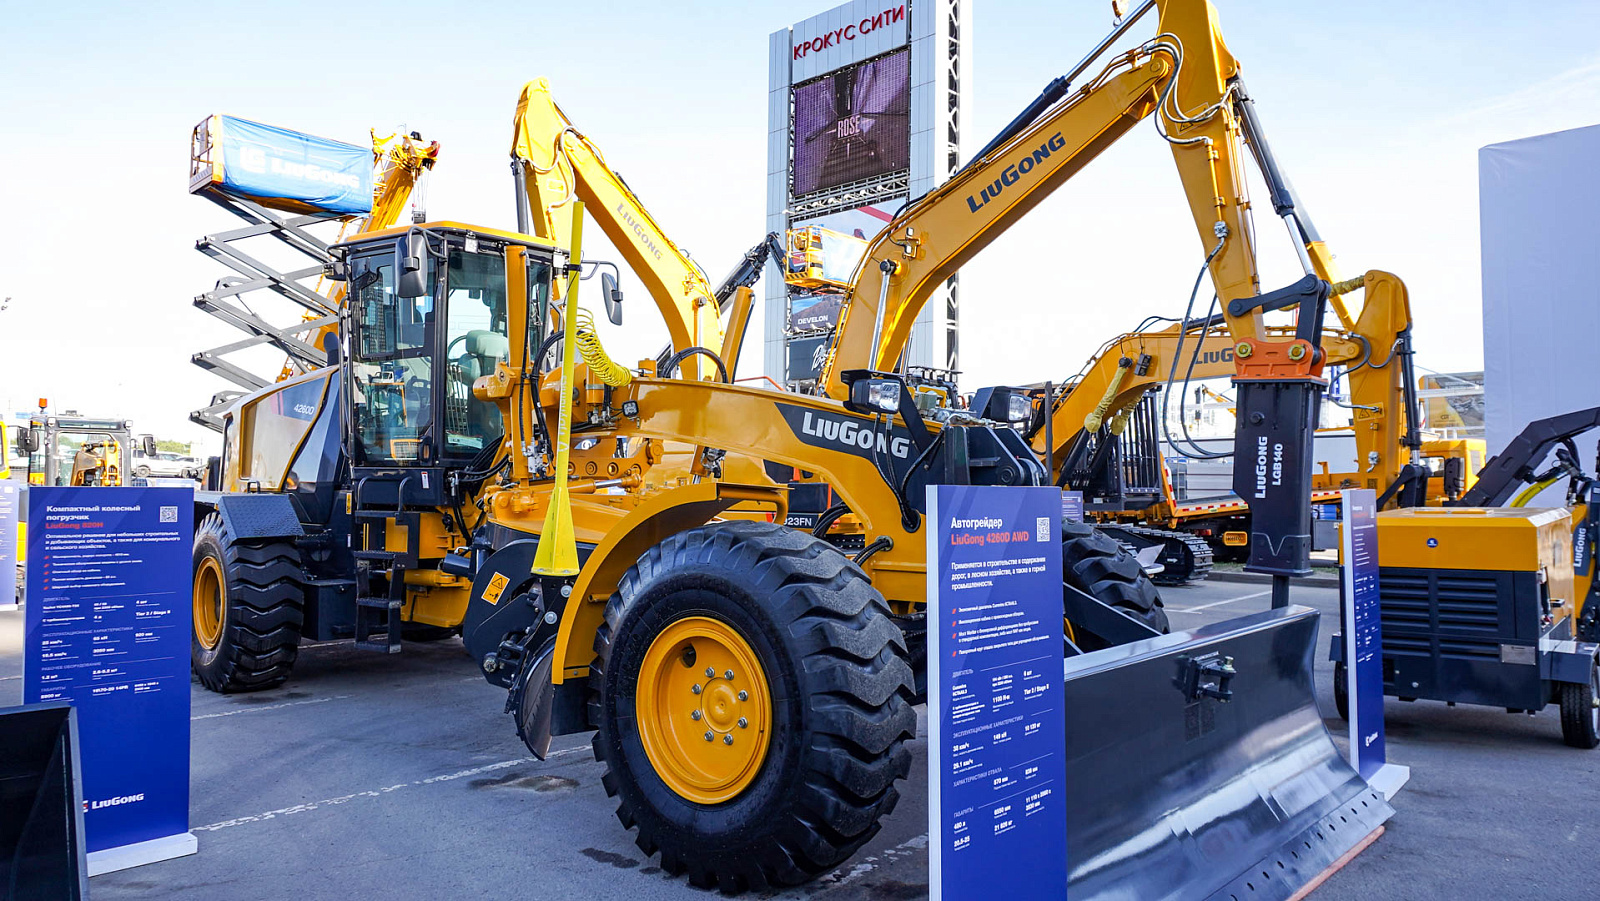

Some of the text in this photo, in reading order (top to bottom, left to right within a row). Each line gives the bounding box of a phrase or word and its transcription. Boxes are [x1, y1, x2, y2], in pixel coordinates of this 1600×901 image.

[793, 5, 904, 60] КРОКУС СИТИ
[838, 115, 861, 138] ROSE
[797, 315, 829, 325] DEVELON
[1272, 443, 1283, 486] LGB140
[101, 504, 141, 512] колесный
[951, 516, 1003, 530] Автогрейдер
[951, 533, 985, 546] LiuGong
[1012, 531, 1029, 542] AWD
